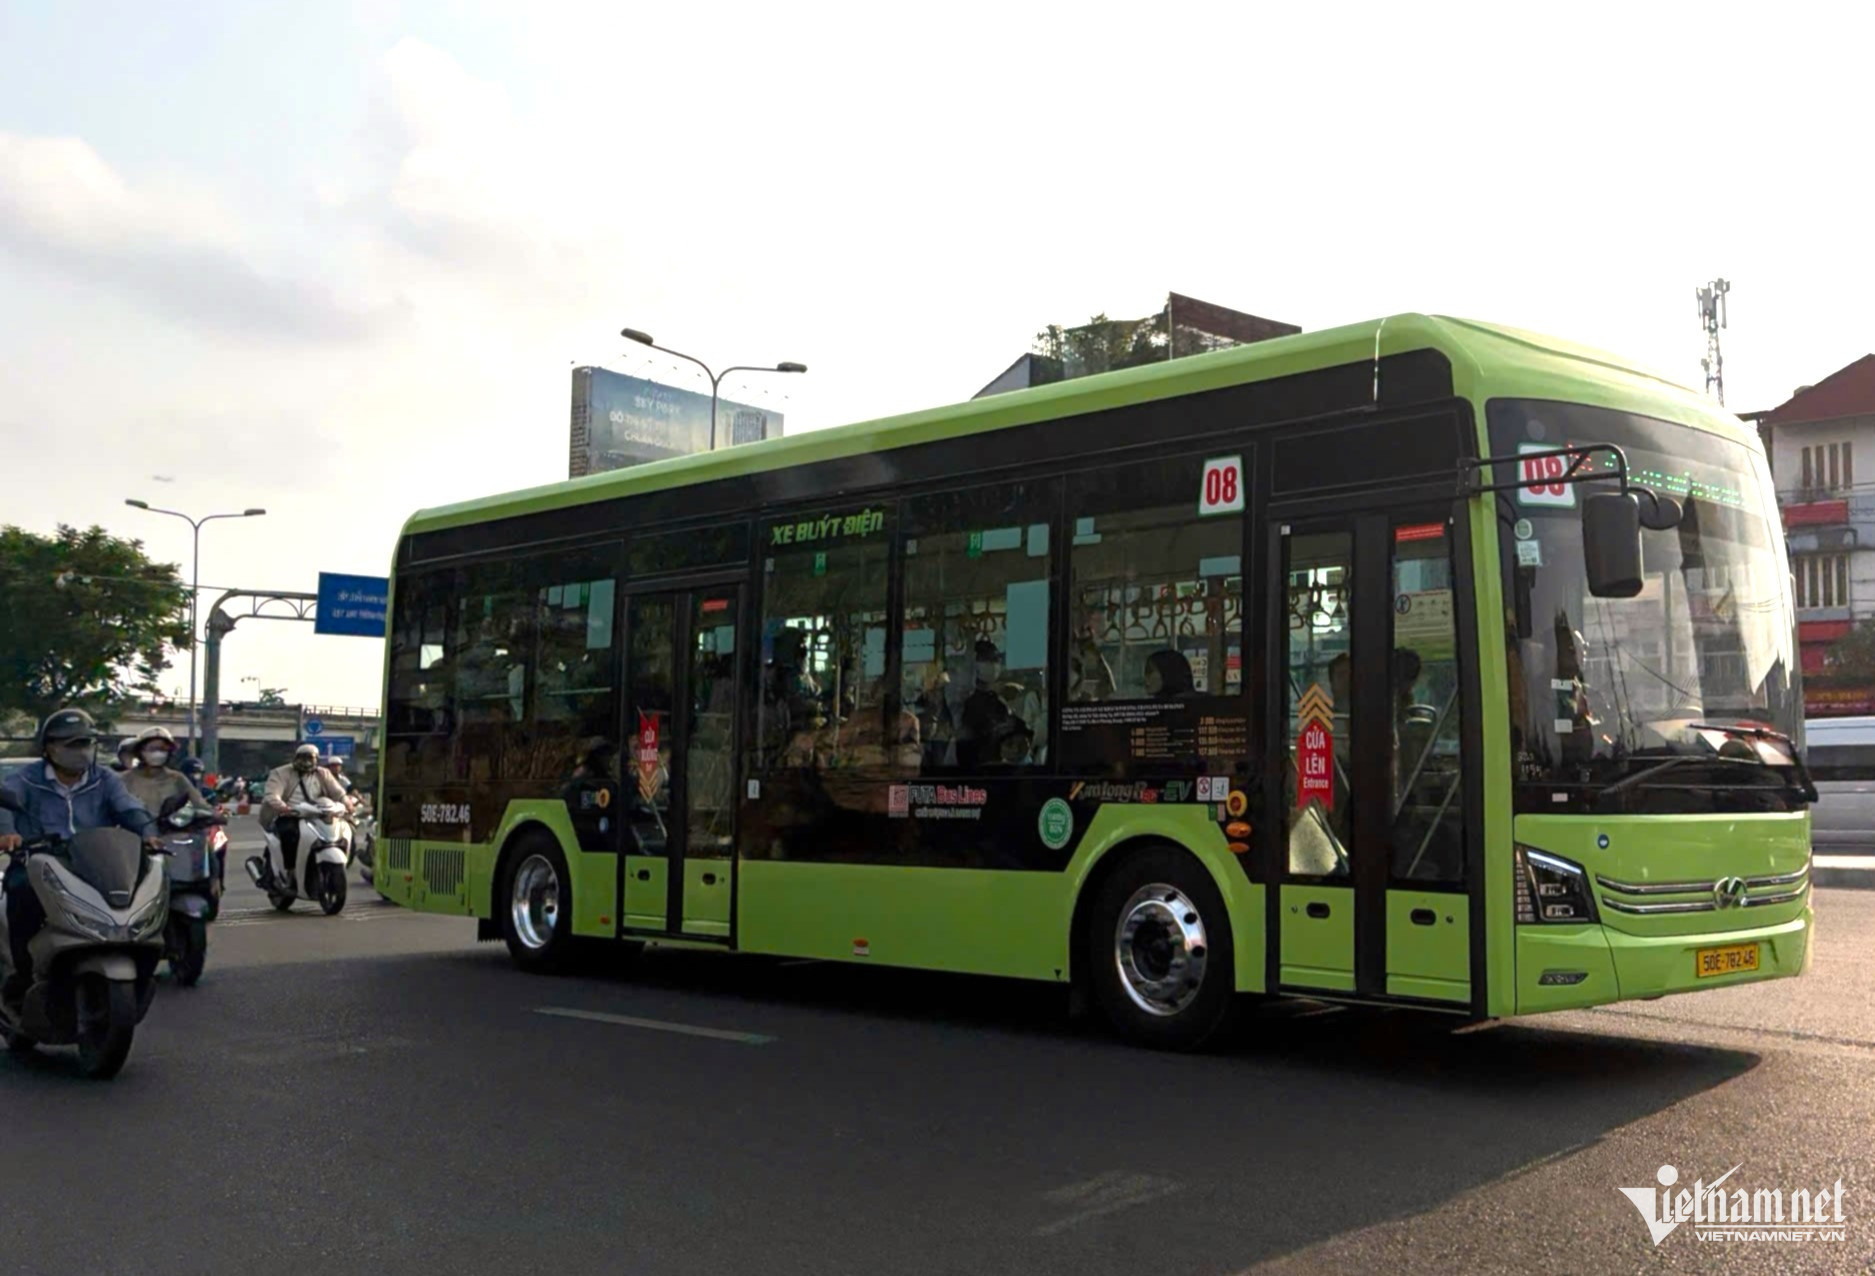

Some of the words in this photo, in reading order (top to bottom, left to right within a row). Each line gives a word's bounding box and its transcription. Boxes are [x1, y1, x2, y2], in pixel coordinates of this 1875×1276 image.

[1206, 465, 1237, 505] 08
[1523, 455, 1565, 497] 08
[770, 524, 795, 546] XE
[795, 514, 842, 542] BUÝT
[1305, 726, 1326, 750] CỬA
[1305, 753, 1326, 776] LÊN
[1303, 777, 1329, 790] Entrance
[420, 803, 471, 824] 50E-782.46
